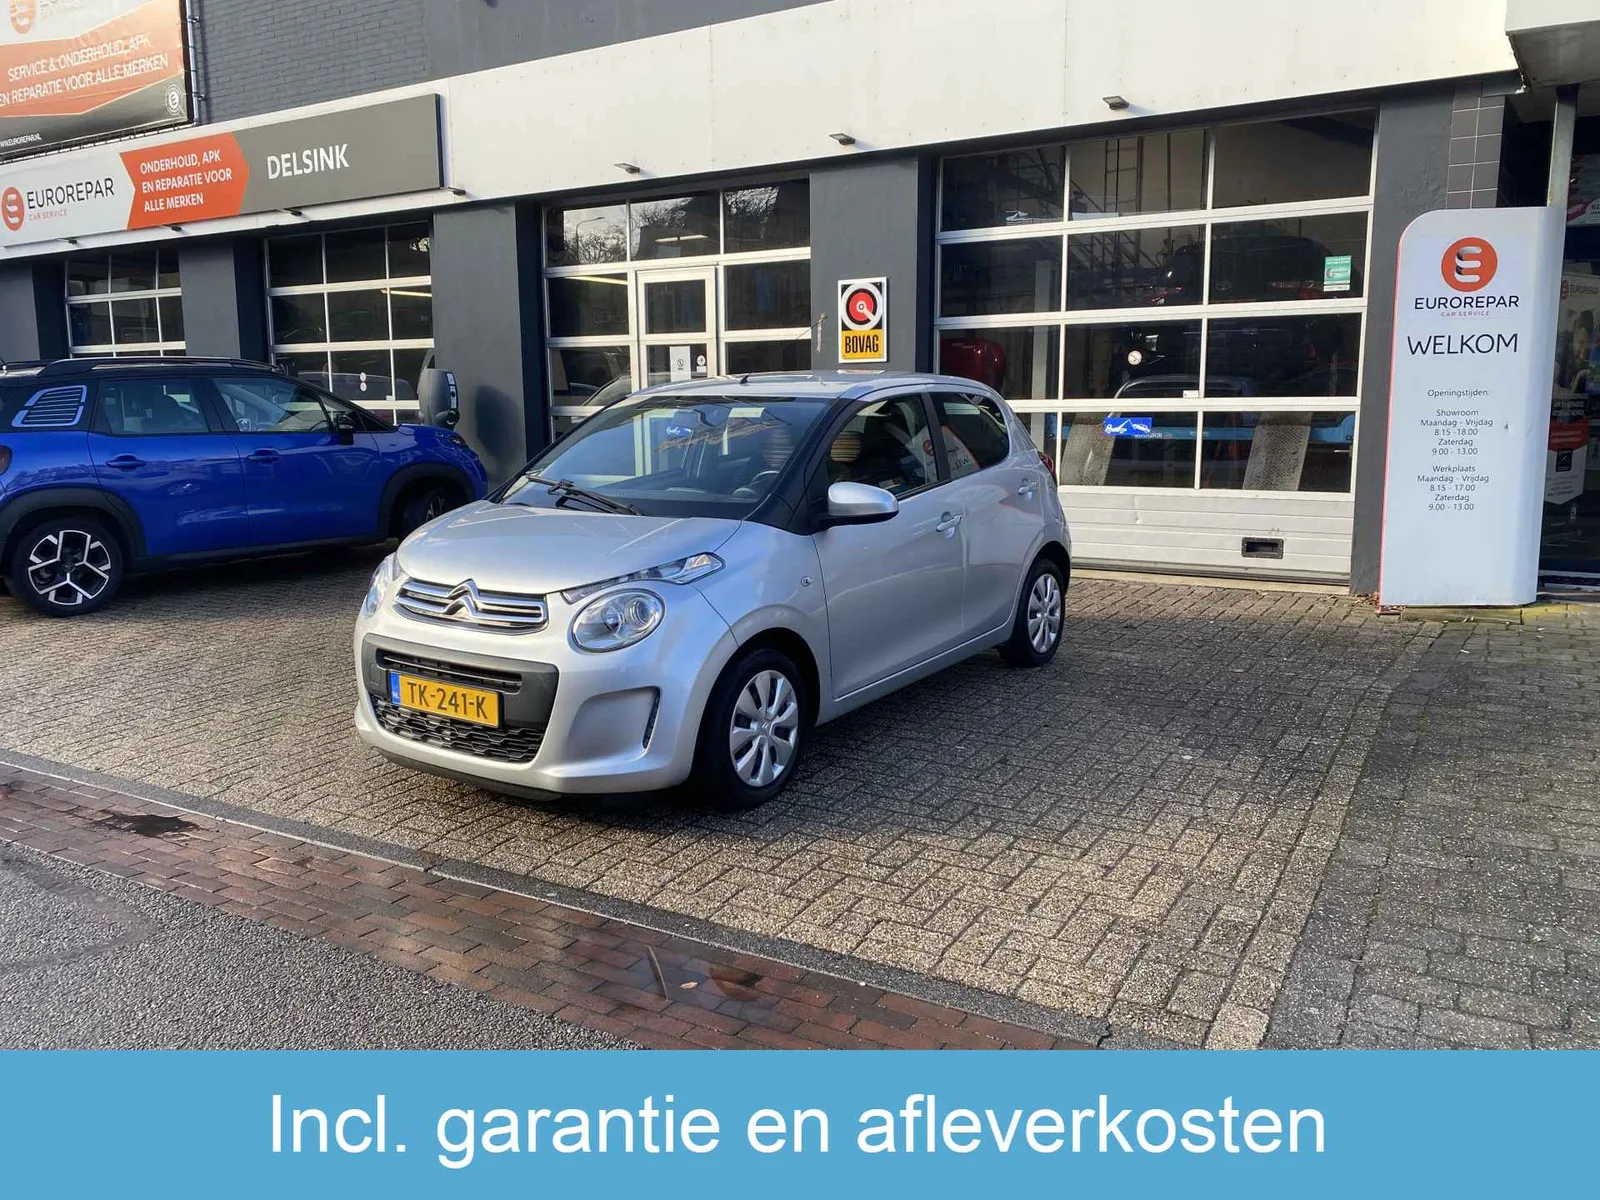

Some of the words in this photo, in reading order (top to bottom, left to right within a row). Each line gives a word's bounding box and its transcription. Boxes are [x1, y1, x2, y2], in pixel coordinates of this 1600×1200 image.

[8, 60, 48, 82] SERVICE
[49, 57, 57, 72] &
[11, 79, 63, 104] REPARATIE
[63, 71, 93, 91] VOOR
[94, 64, 124, 85] ALLE
[123, 53, 168, 77] MERKEN
[140, 154, 200, 175] ONDERHOUD,
[202, 149, 221, 164] APK
[267, 143, 350, 180] DELSINK
[27, 178, 115, 209] EUROREPAR
[142, 181, 154, 194] EN
[155, 173, 203, 192] REPARATIE
[203, 168, 232, 185] VOOR
[29, 212, 41, 221] CAR
[41, 209, 68, 220] SERVICE
[144, 198, 165, 213] ALLE
[166, 192, 204, 211] MERKEN
[1414, 295, 1519, 310] EUROREPAR
[844, 334, 879, 354] BOVAG
[1407, 333, 1518, 355] WELKOM
[407, 682, 488, 719] TK-241-K
